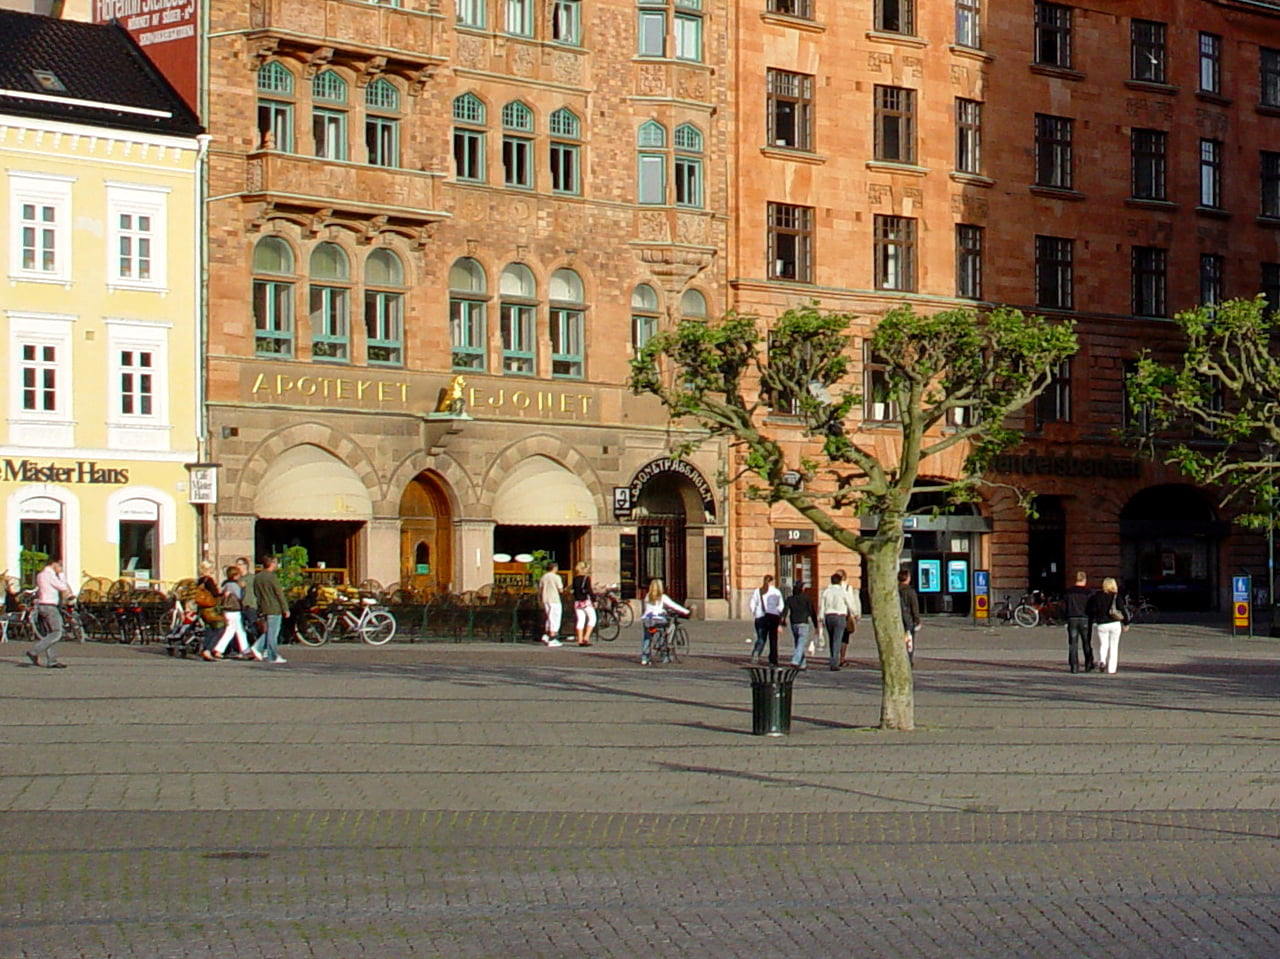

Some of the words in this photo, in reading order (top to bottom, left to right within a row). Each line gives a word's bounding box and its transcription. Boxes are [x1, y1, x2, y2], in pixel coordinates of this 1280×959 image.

[252, 373, 412, 403] APOTEKET
[469, 388, 593, 414] EJONET
[3, 459, 76, 482] Mäster
[76, 461, 129, 484] Hans
[990, 448, 1142, 478] andelsbanken
[788, 530, 800, 540] 10
